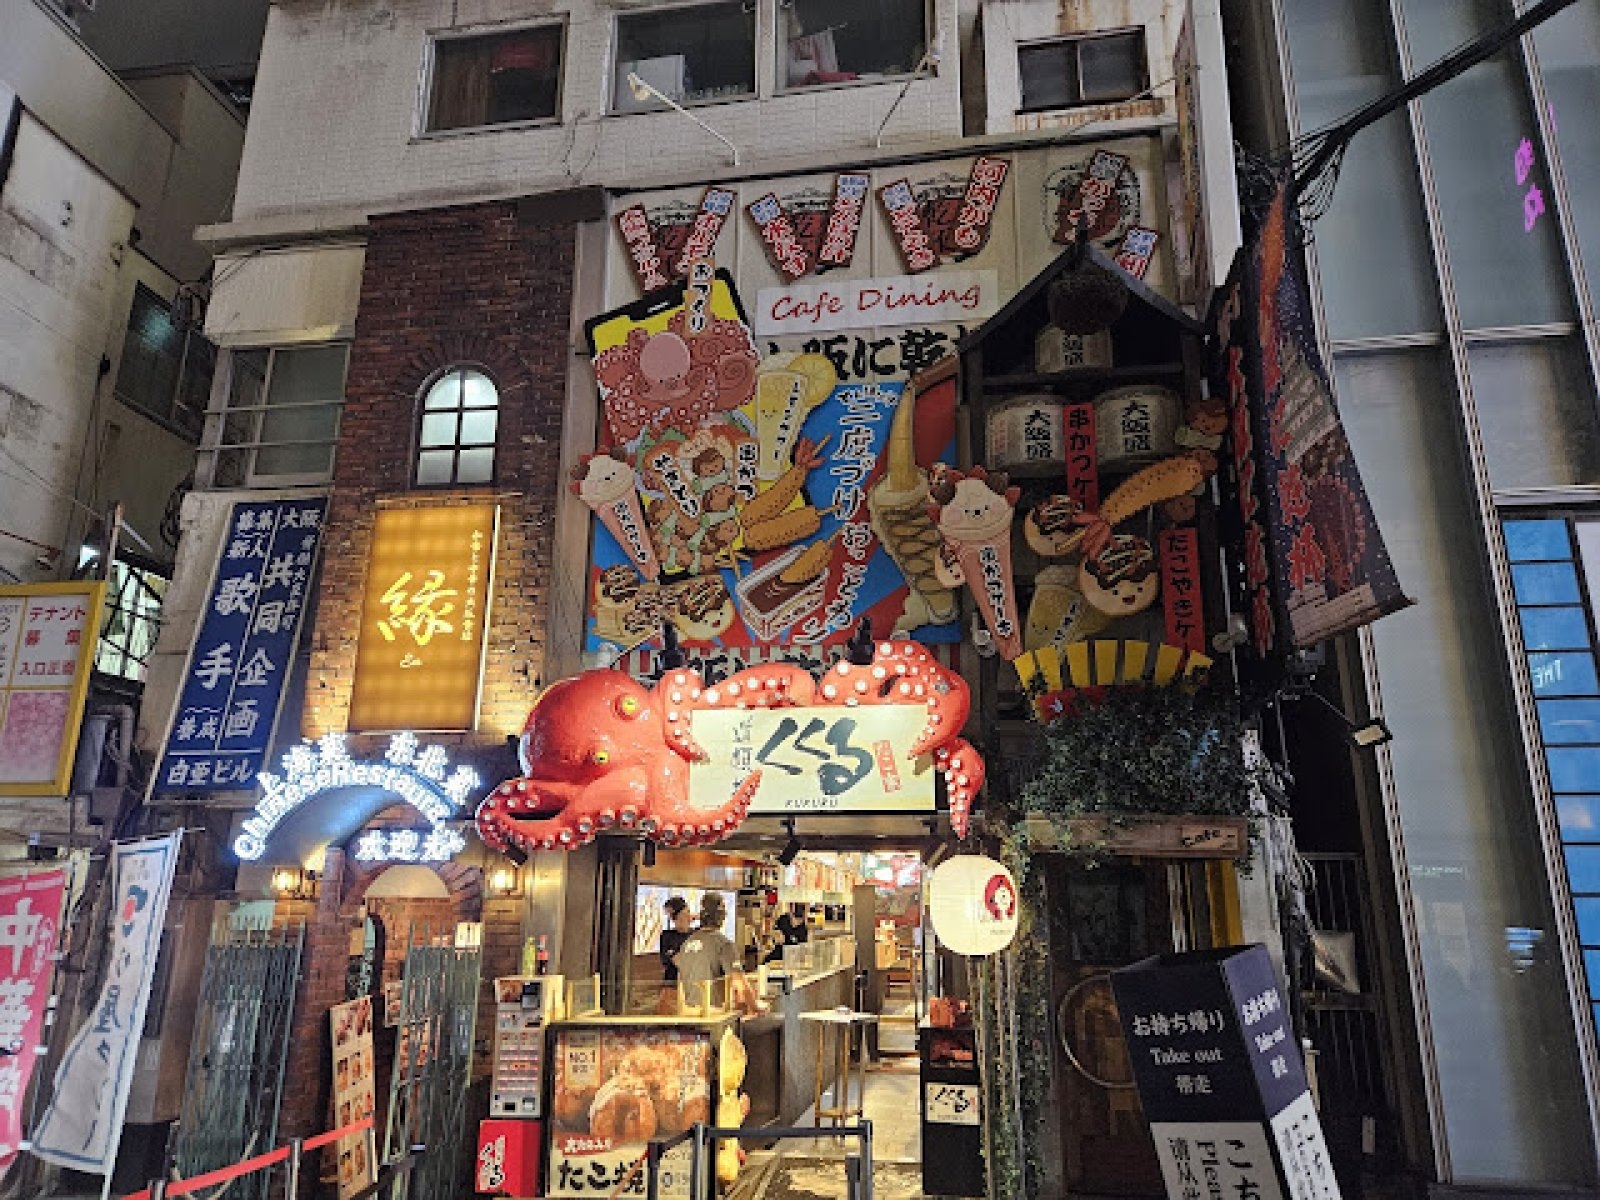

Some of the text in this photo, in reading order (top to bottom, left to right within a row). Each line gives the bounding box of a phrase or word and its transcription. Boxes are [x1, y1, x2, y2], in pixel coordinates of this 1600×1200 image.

[770, 281, 981, 323] Cafe Dining
[653, 452, 700, 518] やきとり
[735, 442, 758, 499] 串かつ
[280, 507, 321, 530] 大阪
[225, 536, 265, 559] 新人
[29, 605, 86, 622] テナント
[195, 572, 260, 690] 歌手
[376, 569, 459, 646] 縁
[225, 552, 295, 738] 共同企画
[756, 716, 874, 796] くくる
[1132, 1009, 1226, 1036] お持ち帰り
[1150, 1047, 1224, 1066] Take out
